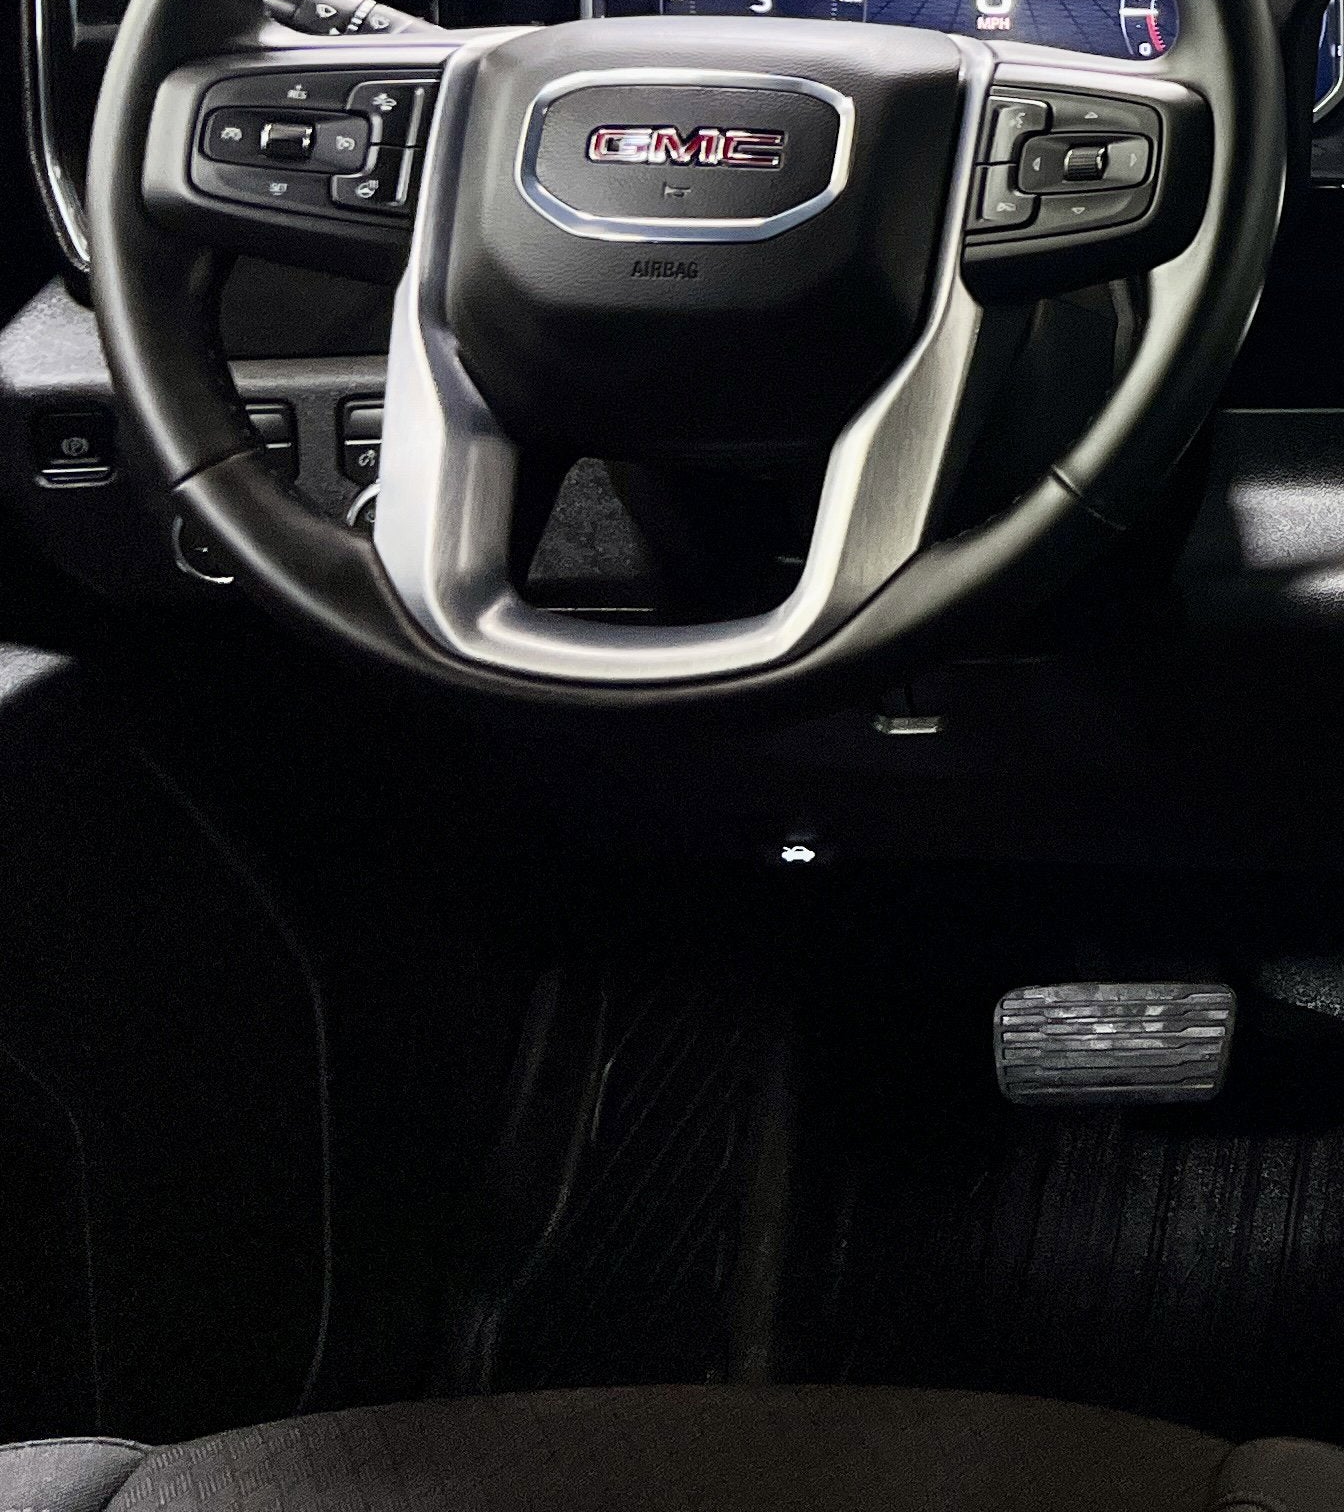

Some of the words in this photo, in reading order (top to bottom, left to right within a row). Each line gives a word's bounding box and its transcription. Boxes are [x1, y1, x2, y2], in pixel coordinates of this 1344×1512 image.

[977, 16, 1011, 30] MPH
[1139, 42, 1151, 56] 0
[586, 124, 786, 169] GMC
[631, 260, 699, 280] AIRBAG
